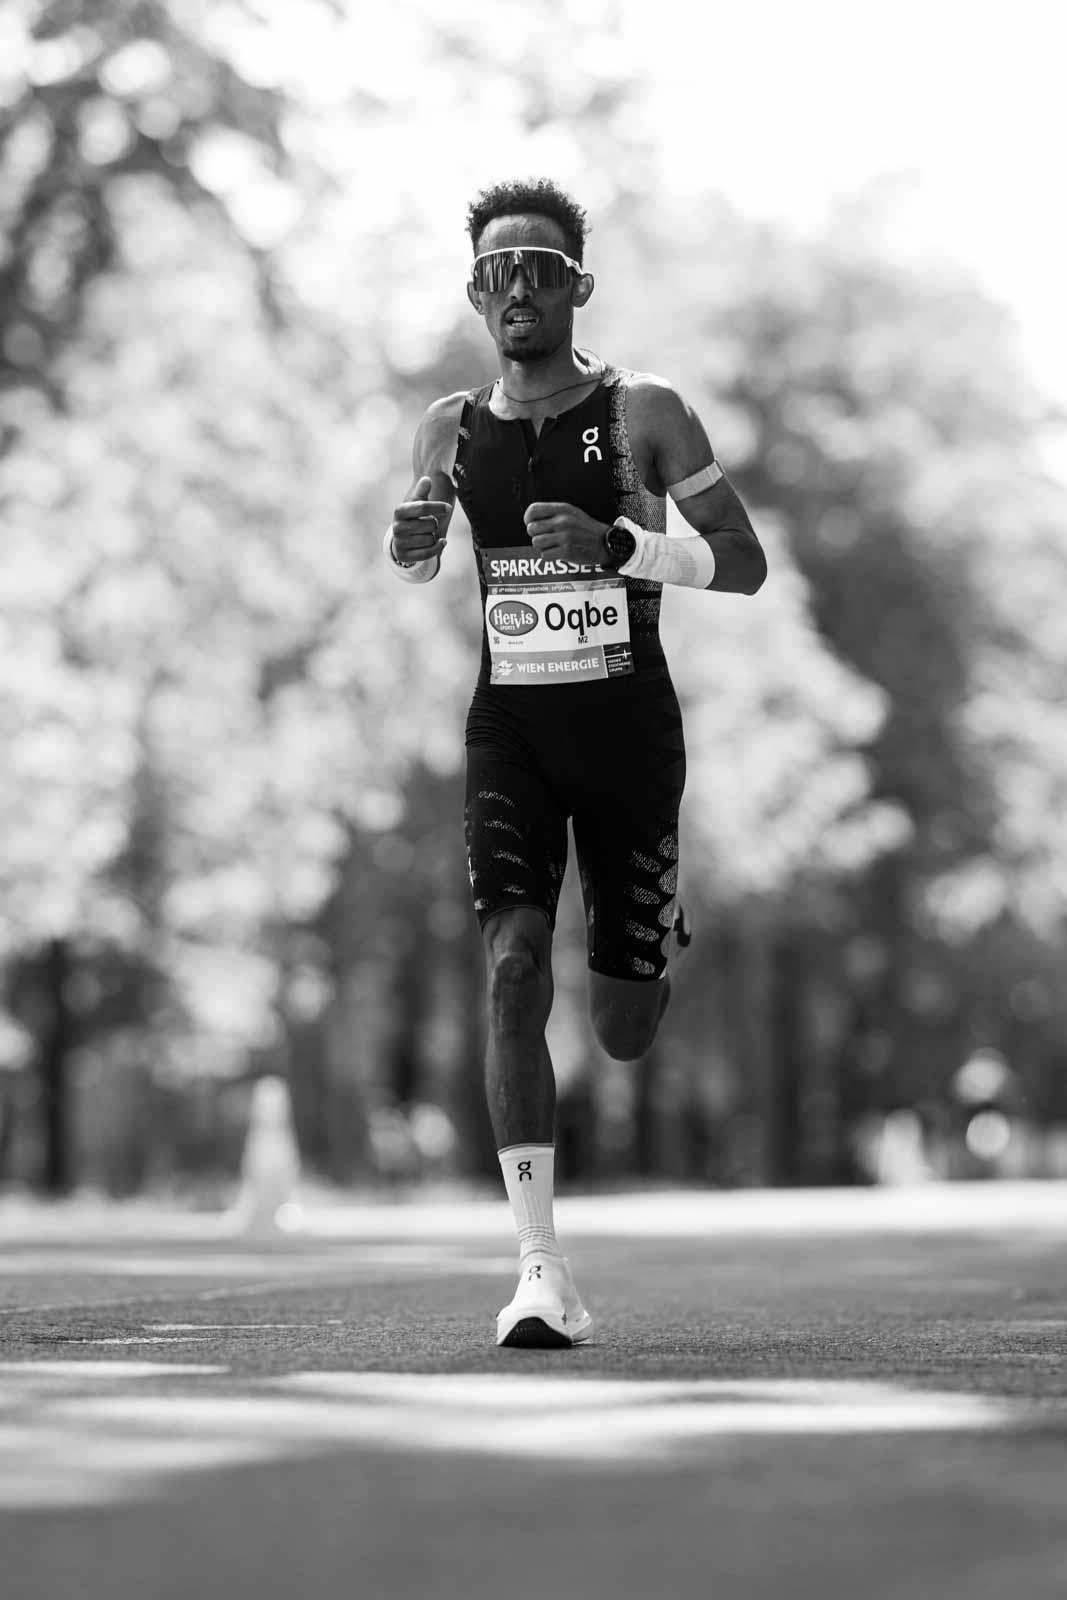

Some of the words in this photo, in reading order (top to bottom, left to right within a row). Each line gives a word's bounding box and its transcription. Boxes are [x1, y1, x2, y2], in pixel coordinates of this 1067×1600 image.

[490, 558, 592, 577] SPARKASSE
[493, 608, 534, 630] Hervis
[544, 601, 618, 636] Oqbe
[577, 636, 589, 645] M2
[516, 662, 546, 674] WIEN
[548, 657, 600, 673] ENERGIE
